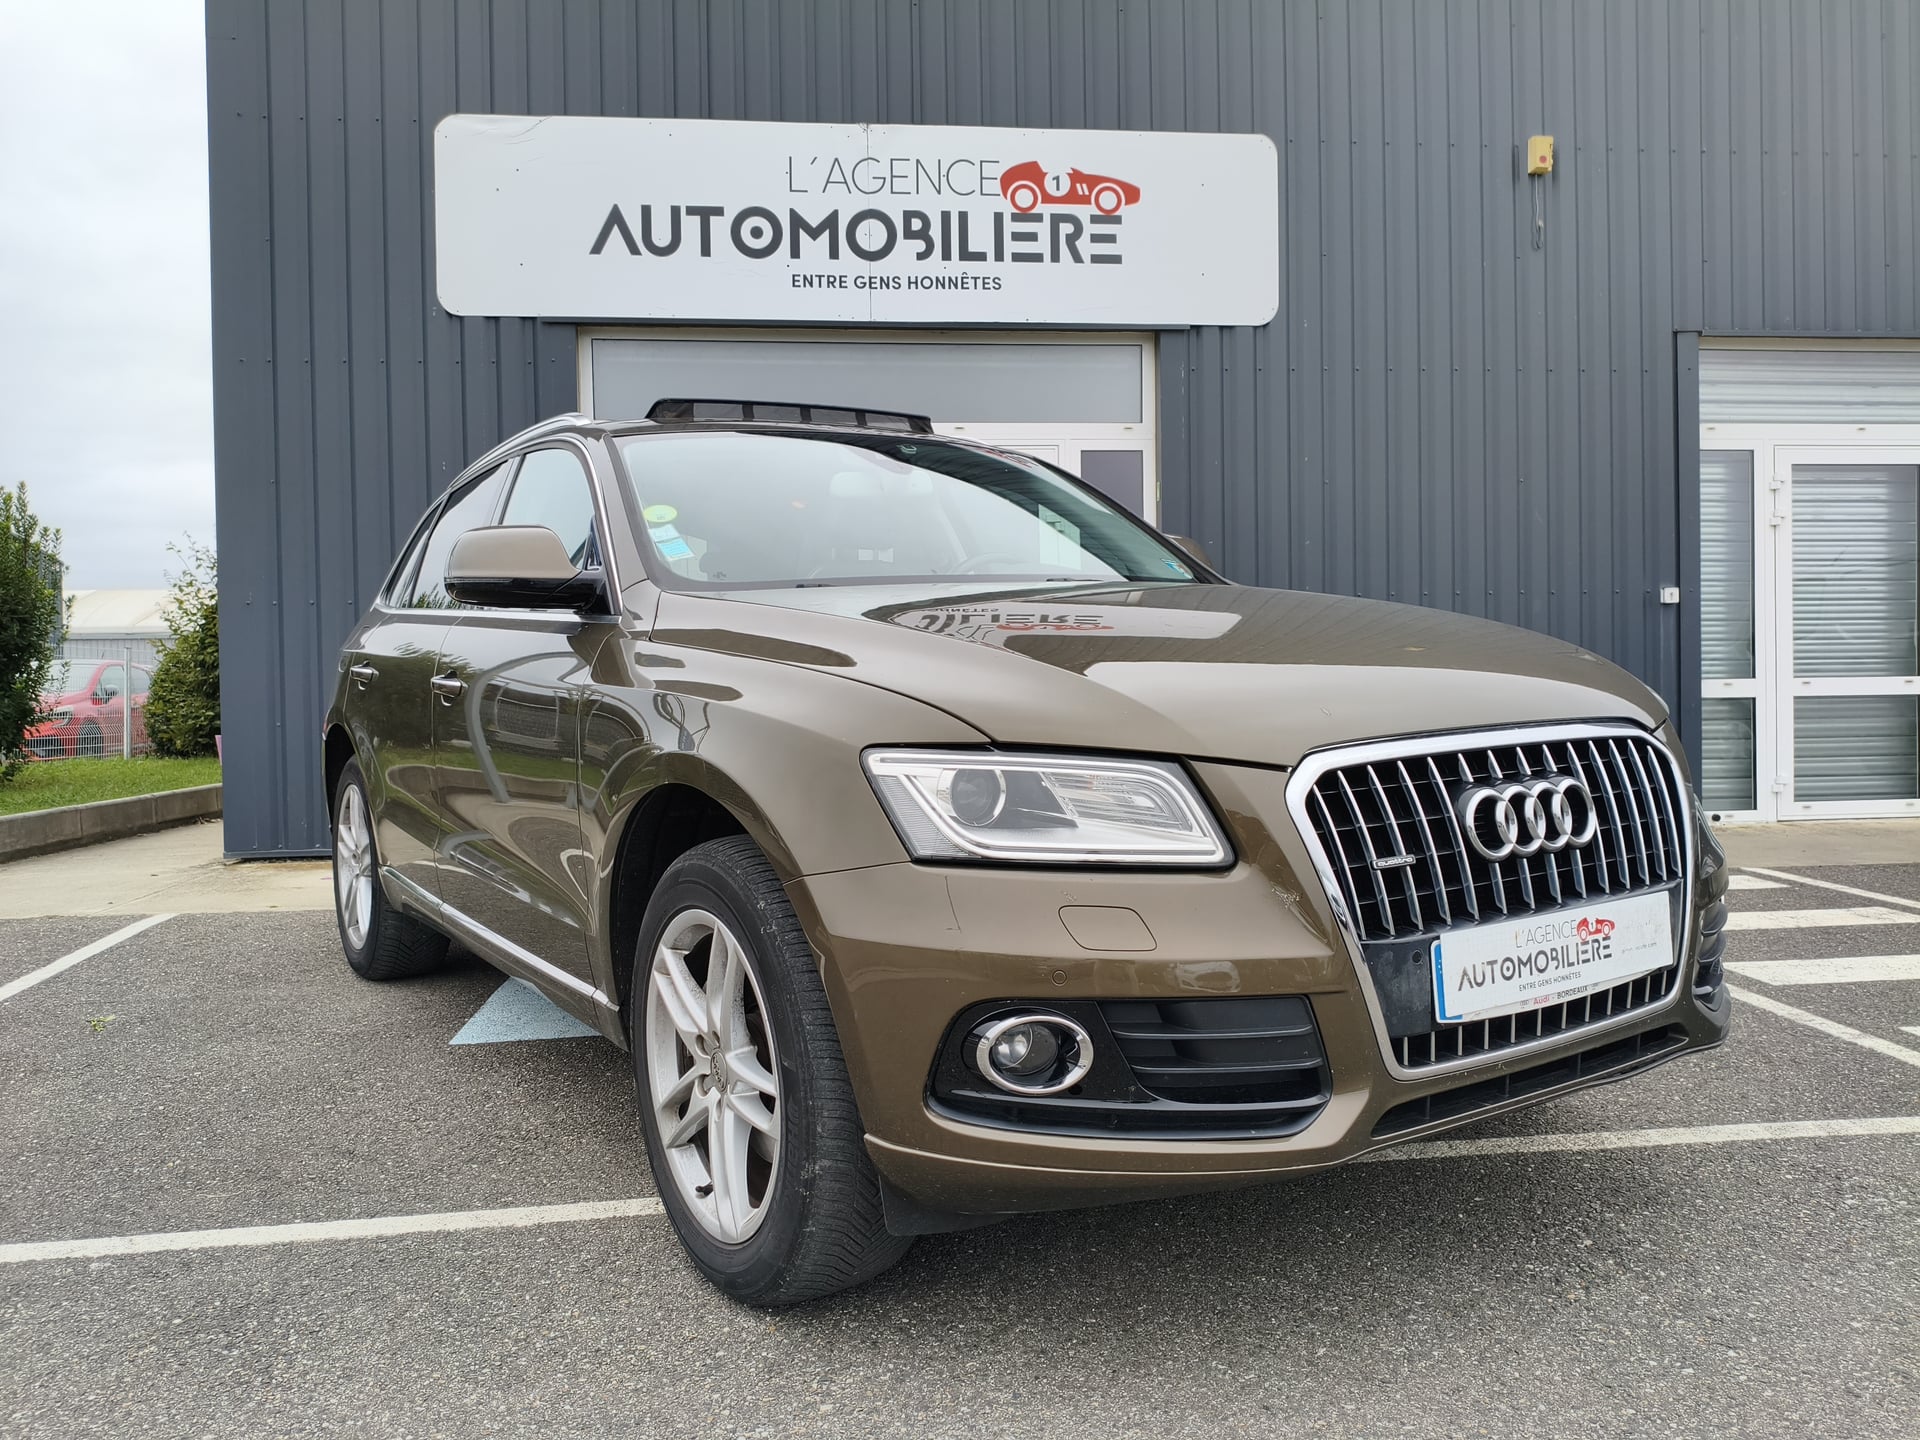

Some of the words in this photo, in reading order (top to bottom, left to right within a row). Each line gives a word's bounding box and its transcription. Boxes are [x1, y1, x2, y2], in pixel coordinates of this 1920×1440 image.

[789, 156, 1000, 197] L'AGENCE
[588, 203, 1123, 265] AUTOMOBILIERE
[791, 273, 848, 289] ENTRE
[853, 275, 902, 290] GENS
[907, 271, 1002, 291] HONNÊTES
[1514, 919, 1577, 949] L'AGENCE
[1457, 936, 1613, 992] AUTOMOBILIERE
[1519, 981, 1537, 992] ENTRE
[1537, 979, 1553, 988] GENS
[1533, 994, 1550, 1006] Audi
[1557, 985, 1588, 1000] BORDEAUX
